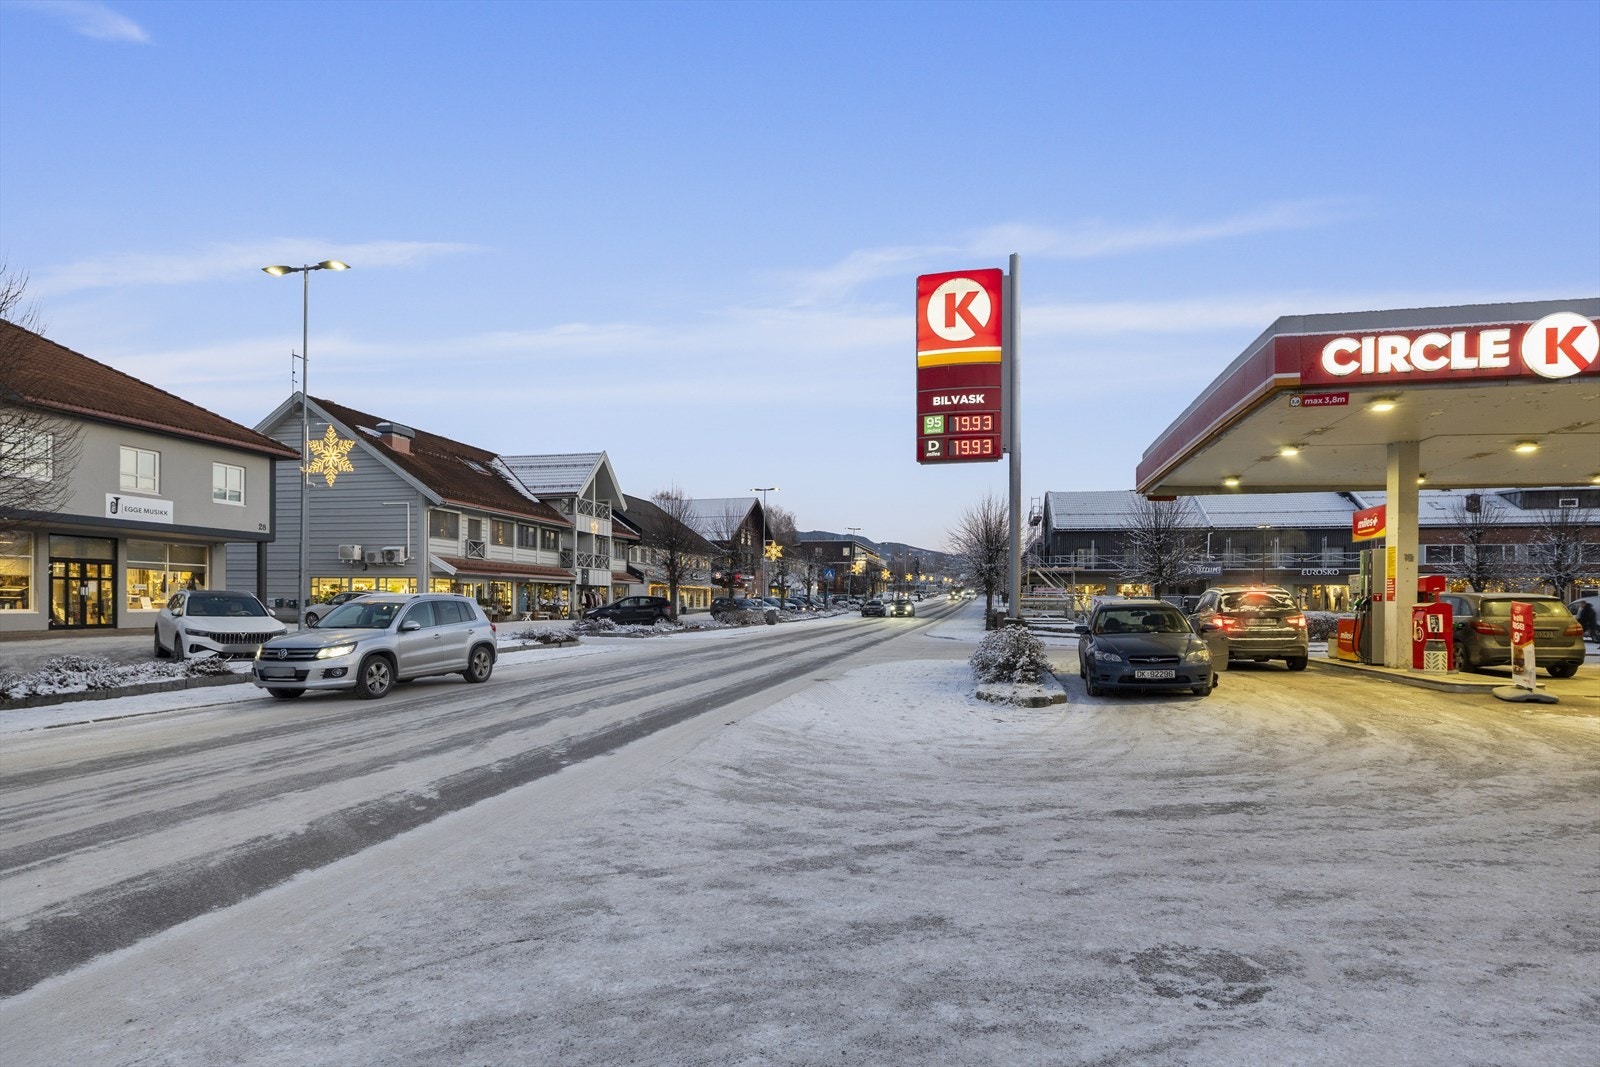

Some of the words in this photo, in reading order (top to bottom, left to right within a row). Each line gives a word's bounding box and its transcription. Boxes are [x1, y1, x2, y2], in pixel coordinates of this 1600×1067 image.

[1321, 327, 1511, 377] CIRCLE
[1542, 324, 1592, 373] K
[932, 393, 985, 406] BILVASK
[1324, 396, 1346, 405] 3,8m
[926, 417, 942, 428] 95
[954, 415, 992, 432] 19.93
[928, 440, 940, 451] D
[954, 439, 992, 455] 19.93
[124, 505, 143, 514] EGGE
[143, 507, 169, 516] MUSIKK
[258, 523, 267, 532] 28
[1301, 568, 1340, 576] EUROSKO
[1136, 670, 1146, 678] DK
